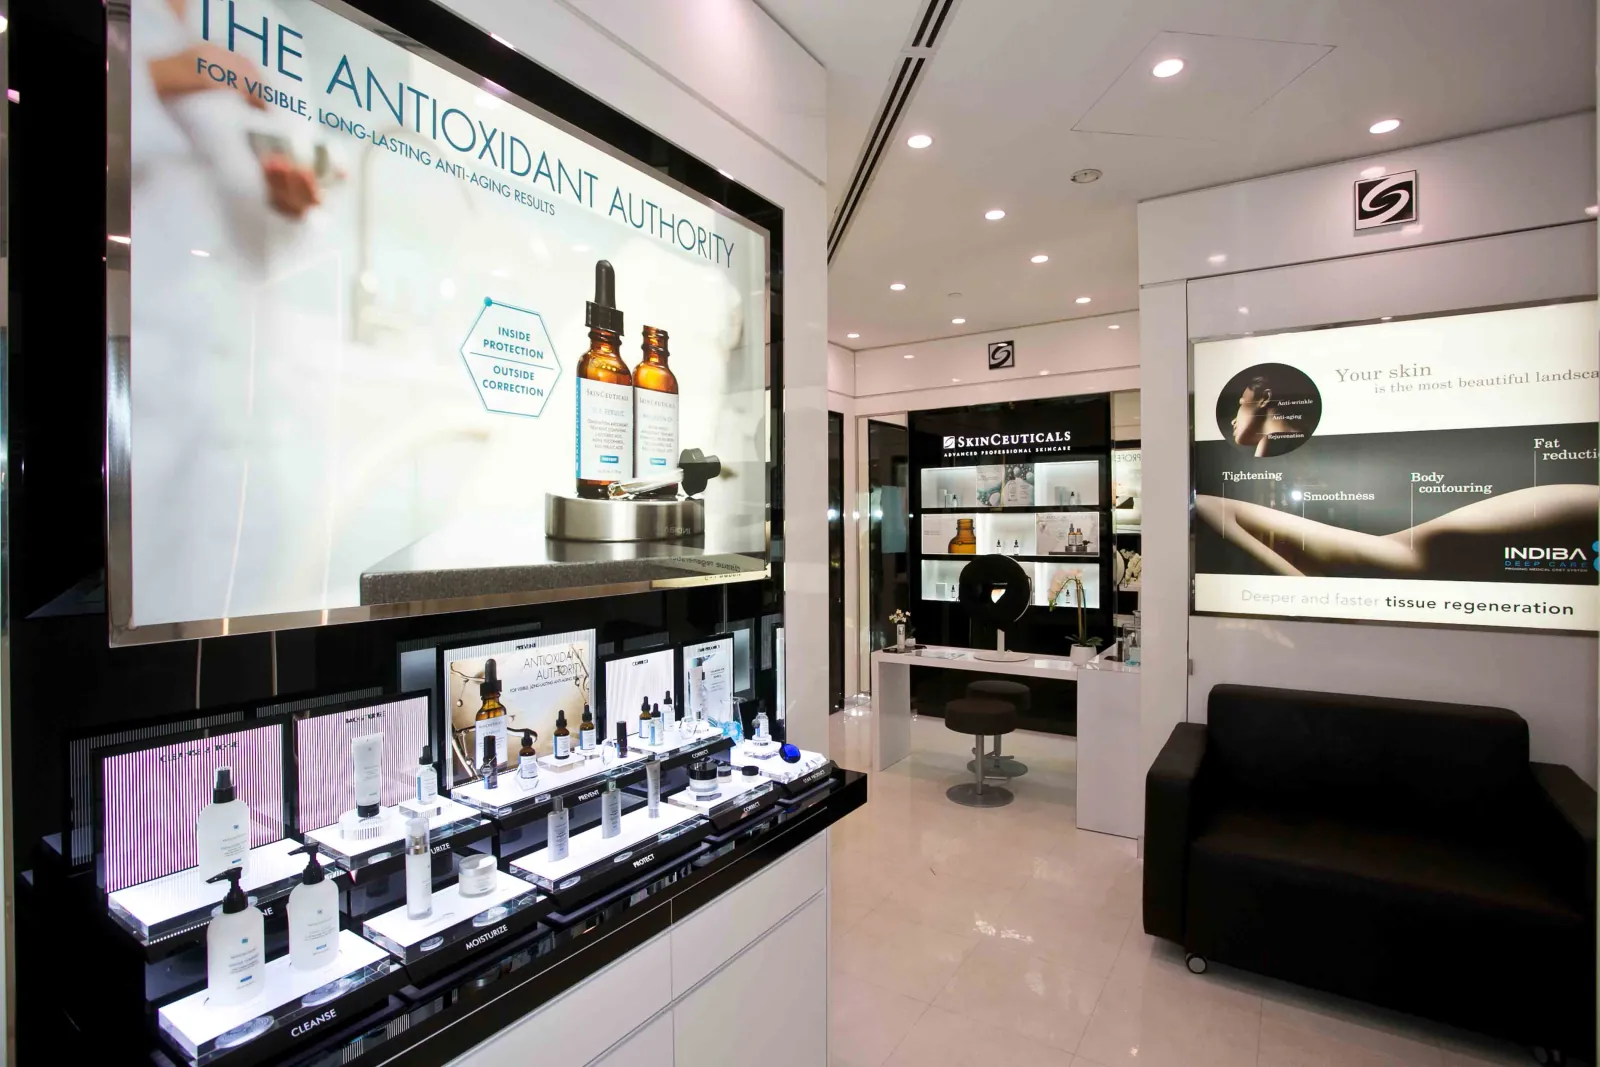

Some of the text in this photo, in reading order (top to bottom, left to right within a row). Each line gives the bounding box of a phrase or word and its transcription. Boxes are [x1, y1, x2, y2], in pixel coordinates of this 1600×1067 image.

[196, 57, 555, 216] FOR VISIBLE, LONG-LASTING ANTI-AGING RESULTS
[326, 54, 599, 208] ANTIOXIDANT
[608, 186, 735, 269] AUTHORITY
[498, 326, 531, 342] INSIDE
[483, 338, 544, 360] PROTECTION
[493, 365, 535, 381] OUTSIDE
[1335, 363, 1432, 383] Your skin
[482, 379, 544, 397] CORRECTION
[1374, 383, 1386, 394] is
[1390, 382, 1413, 393] the
[1418, 380, 1453, 391] most
[1458, 372, 1530, 388] beautiful
[1277, 399, 1313, 407] Anti-wrinkle
[957, 431, 1071, 448] SKINCEUTICALS
[1533, 438, 1560, 449] Fat
[981, 448, 1032, 456] PROFESSIONAL
[1543, 448, 1599, 460] reducti
[1222, 470, 1283, 482] Tightening
[1411, 472, 1445, 484] Body
[1303, 491, 1375, 501] Smoothness
[1419, 482, 1493, 495] contouring
[1504, 547, 1587, 560] INDIBA
[1242, 589, 1574, 615] Deeper and faster tissue regeneration
[523, 648, 583, 668] ANTIOXIDANT
[578, 789, 600, 801] PREVENT
[743, 801, 760, 813] CORRECT
[430, 842, 451, 854] URIZE
[632, 853, 655, 868] PROTECT
[465, 924, 508, 950] MOISTURIZE
[290, 1008, 338, 1038] CLEANSE
